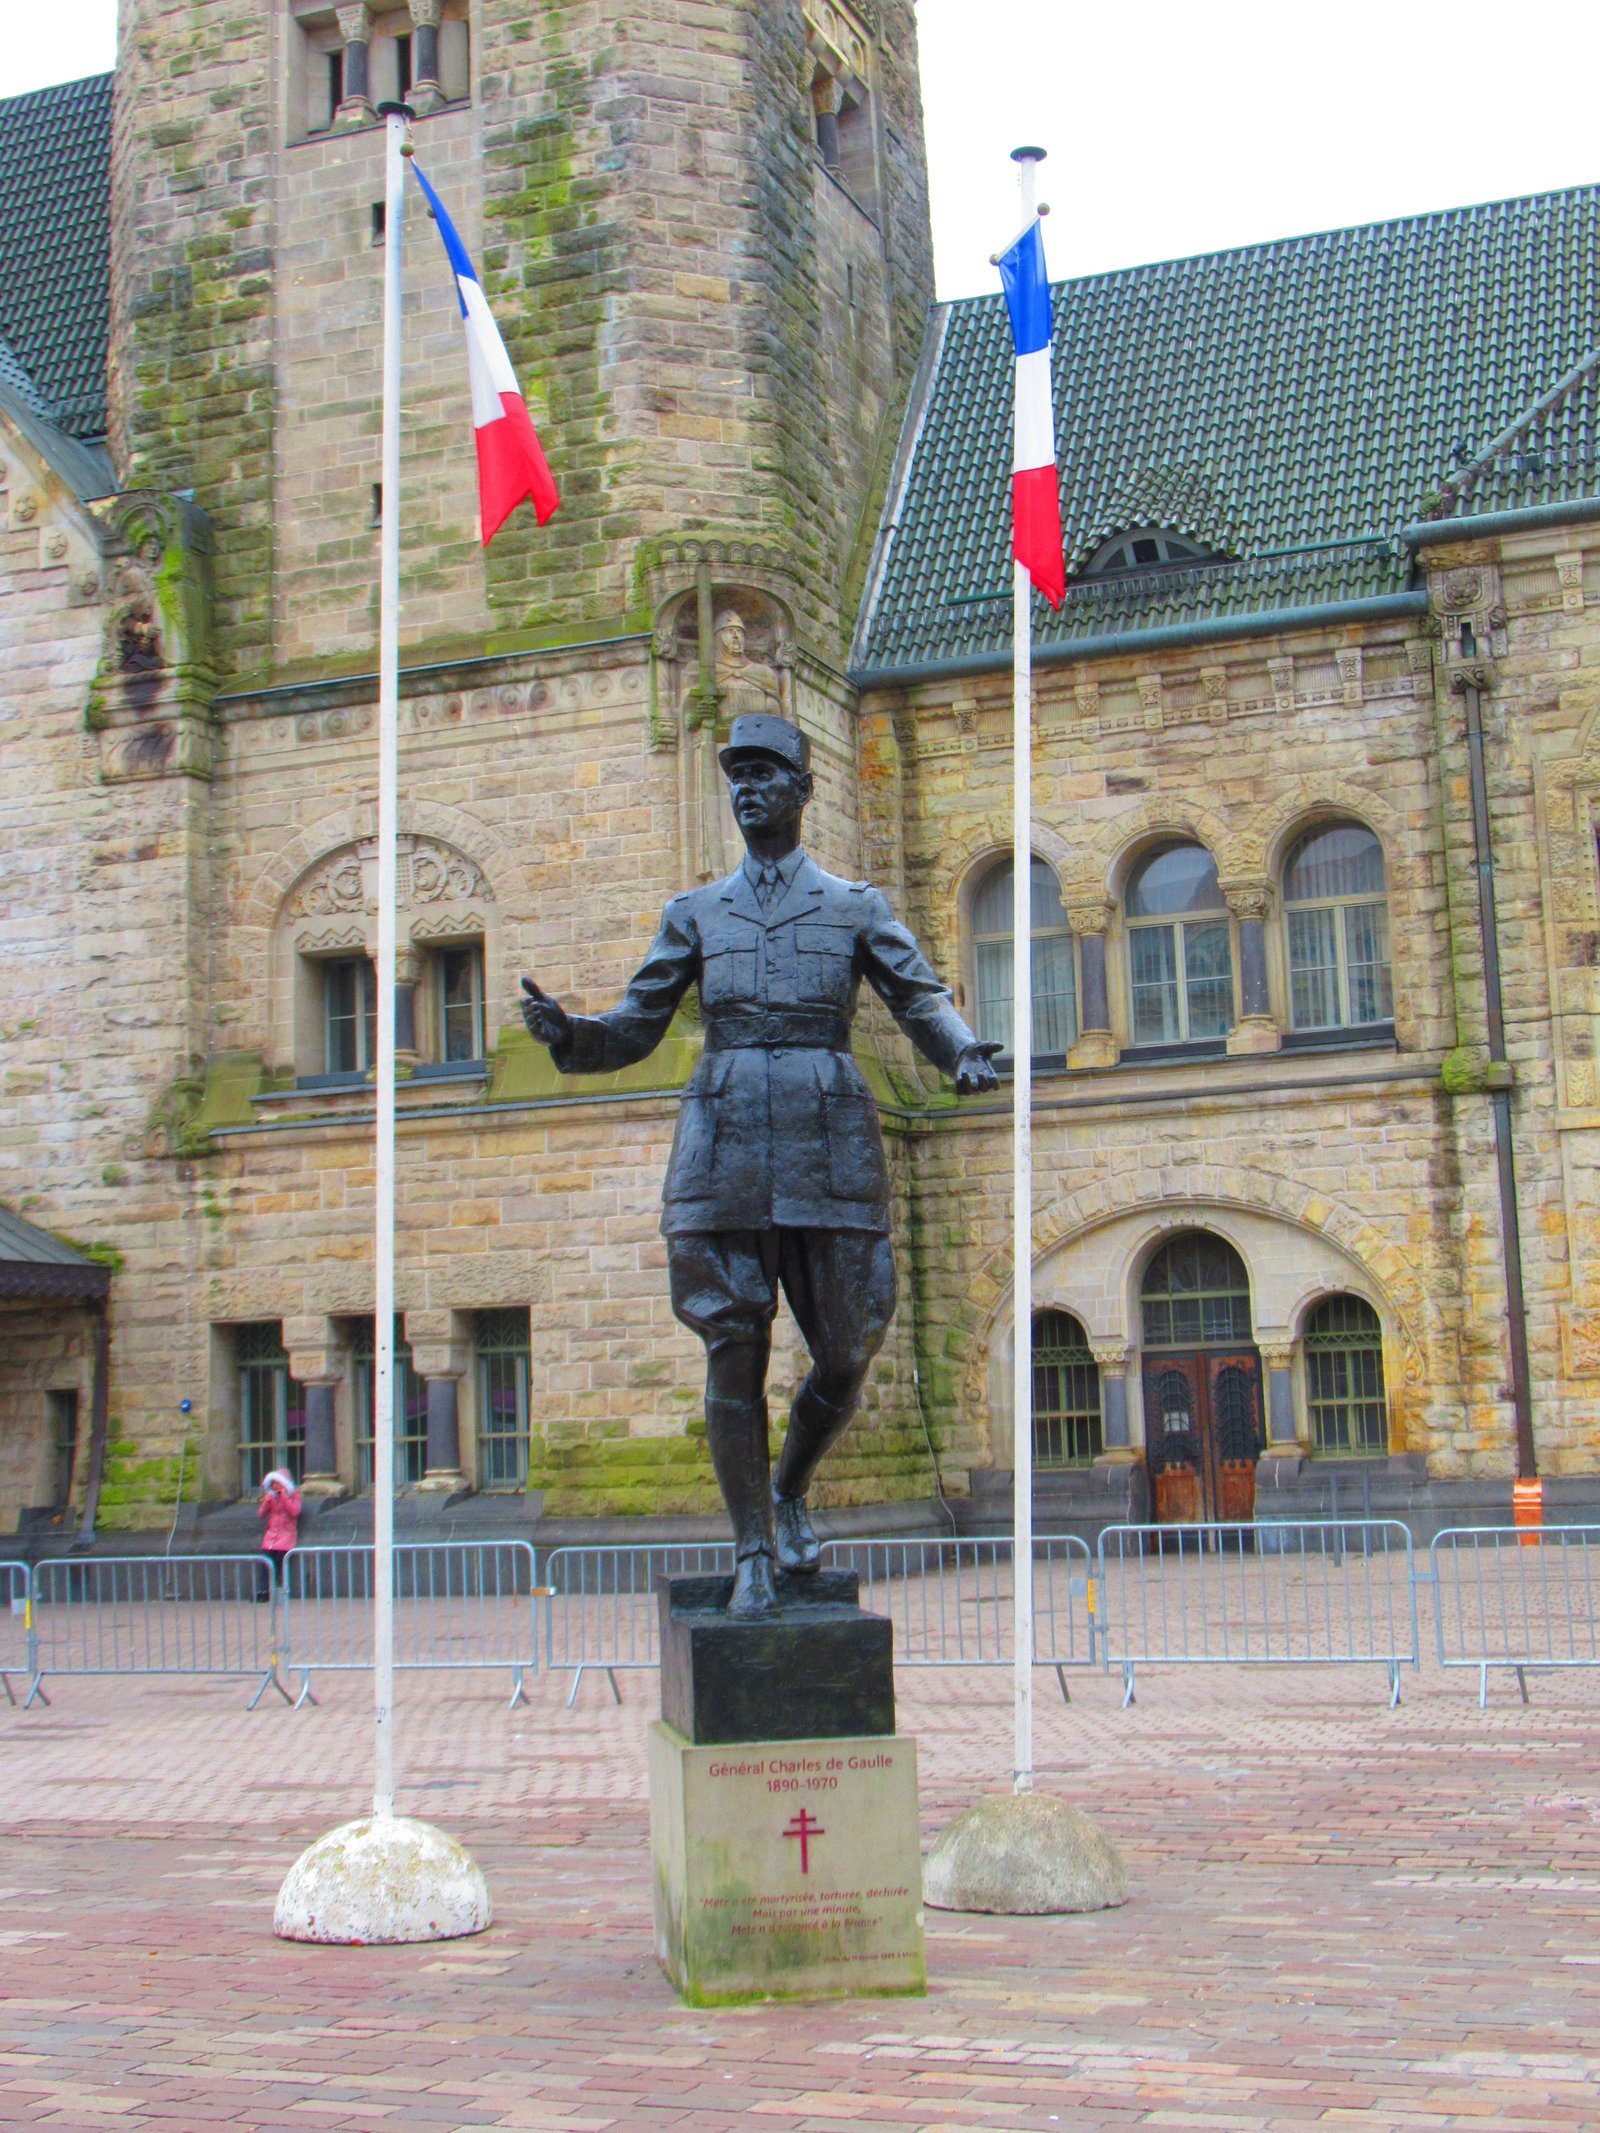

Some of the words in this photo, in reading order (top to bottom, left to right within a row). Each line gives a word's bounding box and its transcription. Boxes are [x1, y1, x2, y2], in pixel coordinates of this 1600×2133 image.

[709, 1760, 764, 1777] Général
[769, 1757, 821, 1774] Charles
[826, 1757, 843, 1770] de
[848, 1754, 893, 1769] Gaulle
[766, 1777, 838, 1793] 1890-1970
[800, 1907, 819, 1917] une
